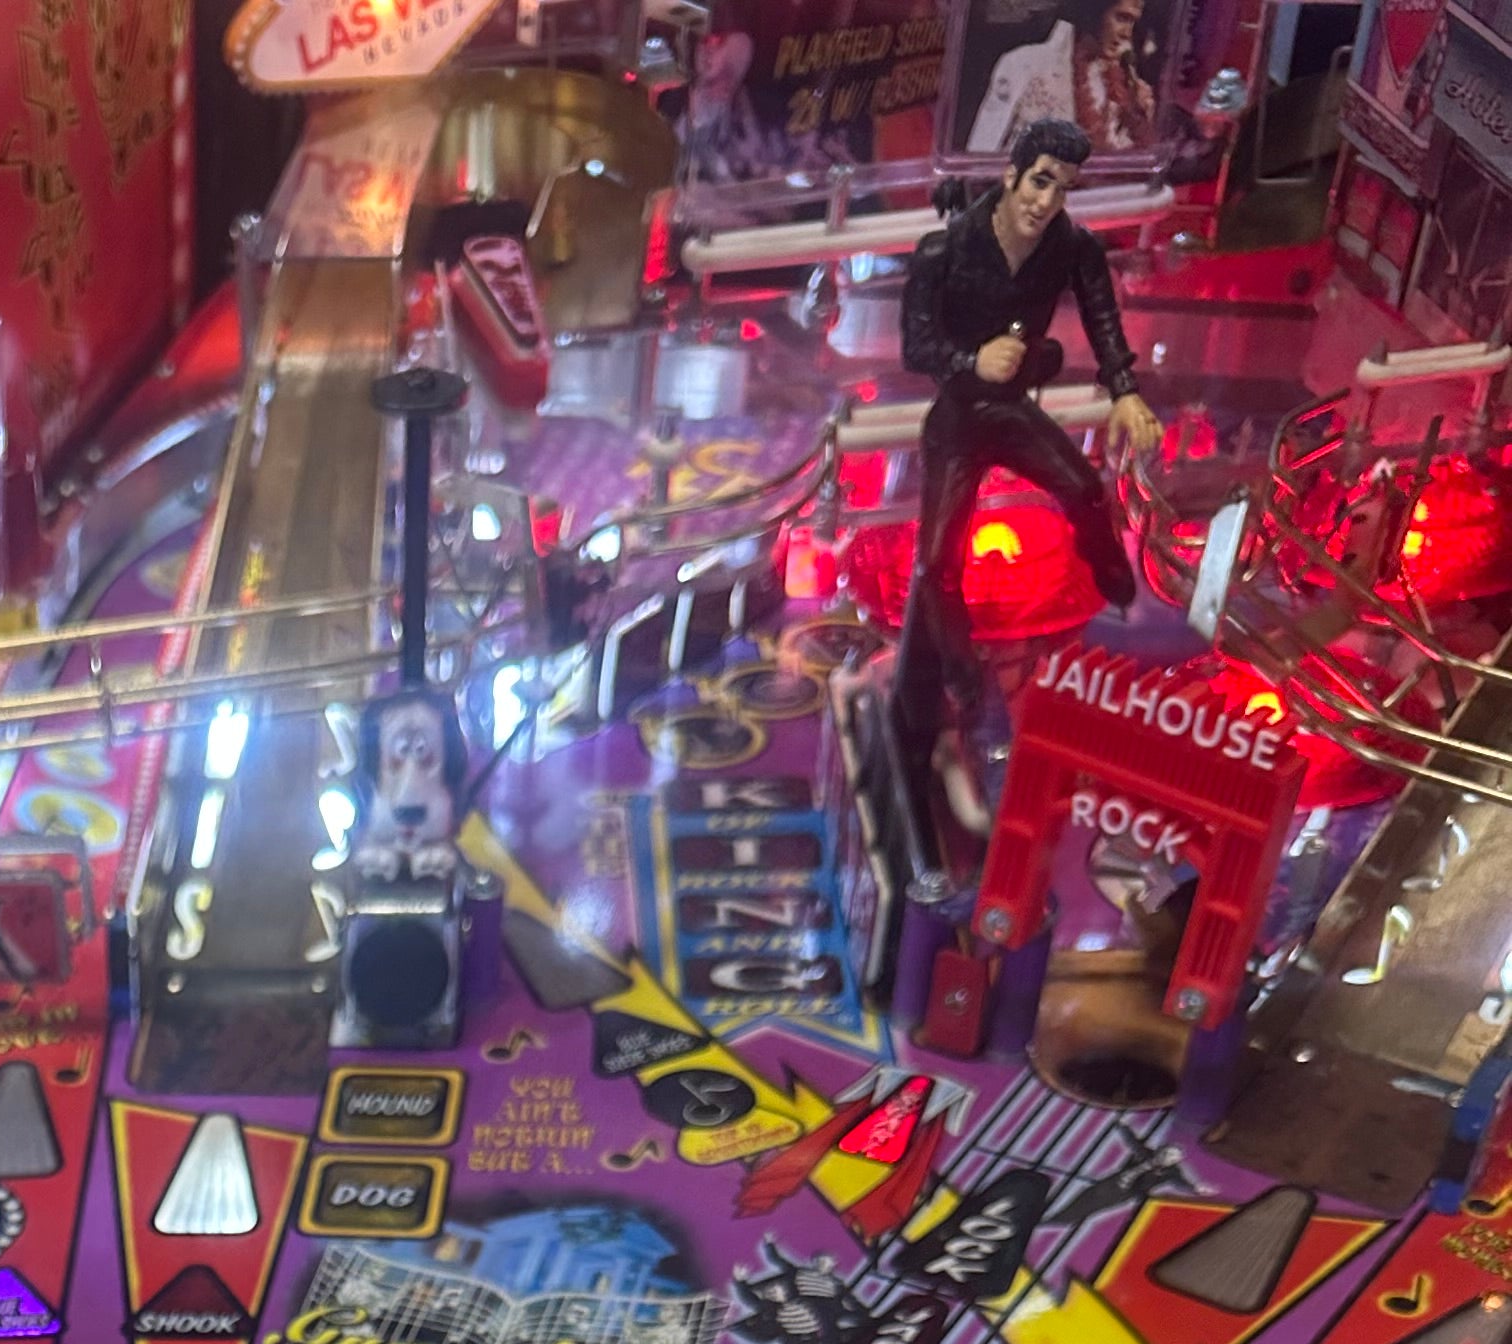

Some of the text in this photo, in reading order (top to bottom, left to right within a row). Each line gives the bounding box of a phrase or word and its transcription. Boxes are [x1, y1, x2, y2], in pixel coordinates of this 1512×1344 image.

[1036, 652, 1284, 772] JAILHOUSE
[1070, 793, 1186, 864] ROCK
[329, 1181, 418, 1209] DOG
[135, 1311, 242, 1335] SHOOK
